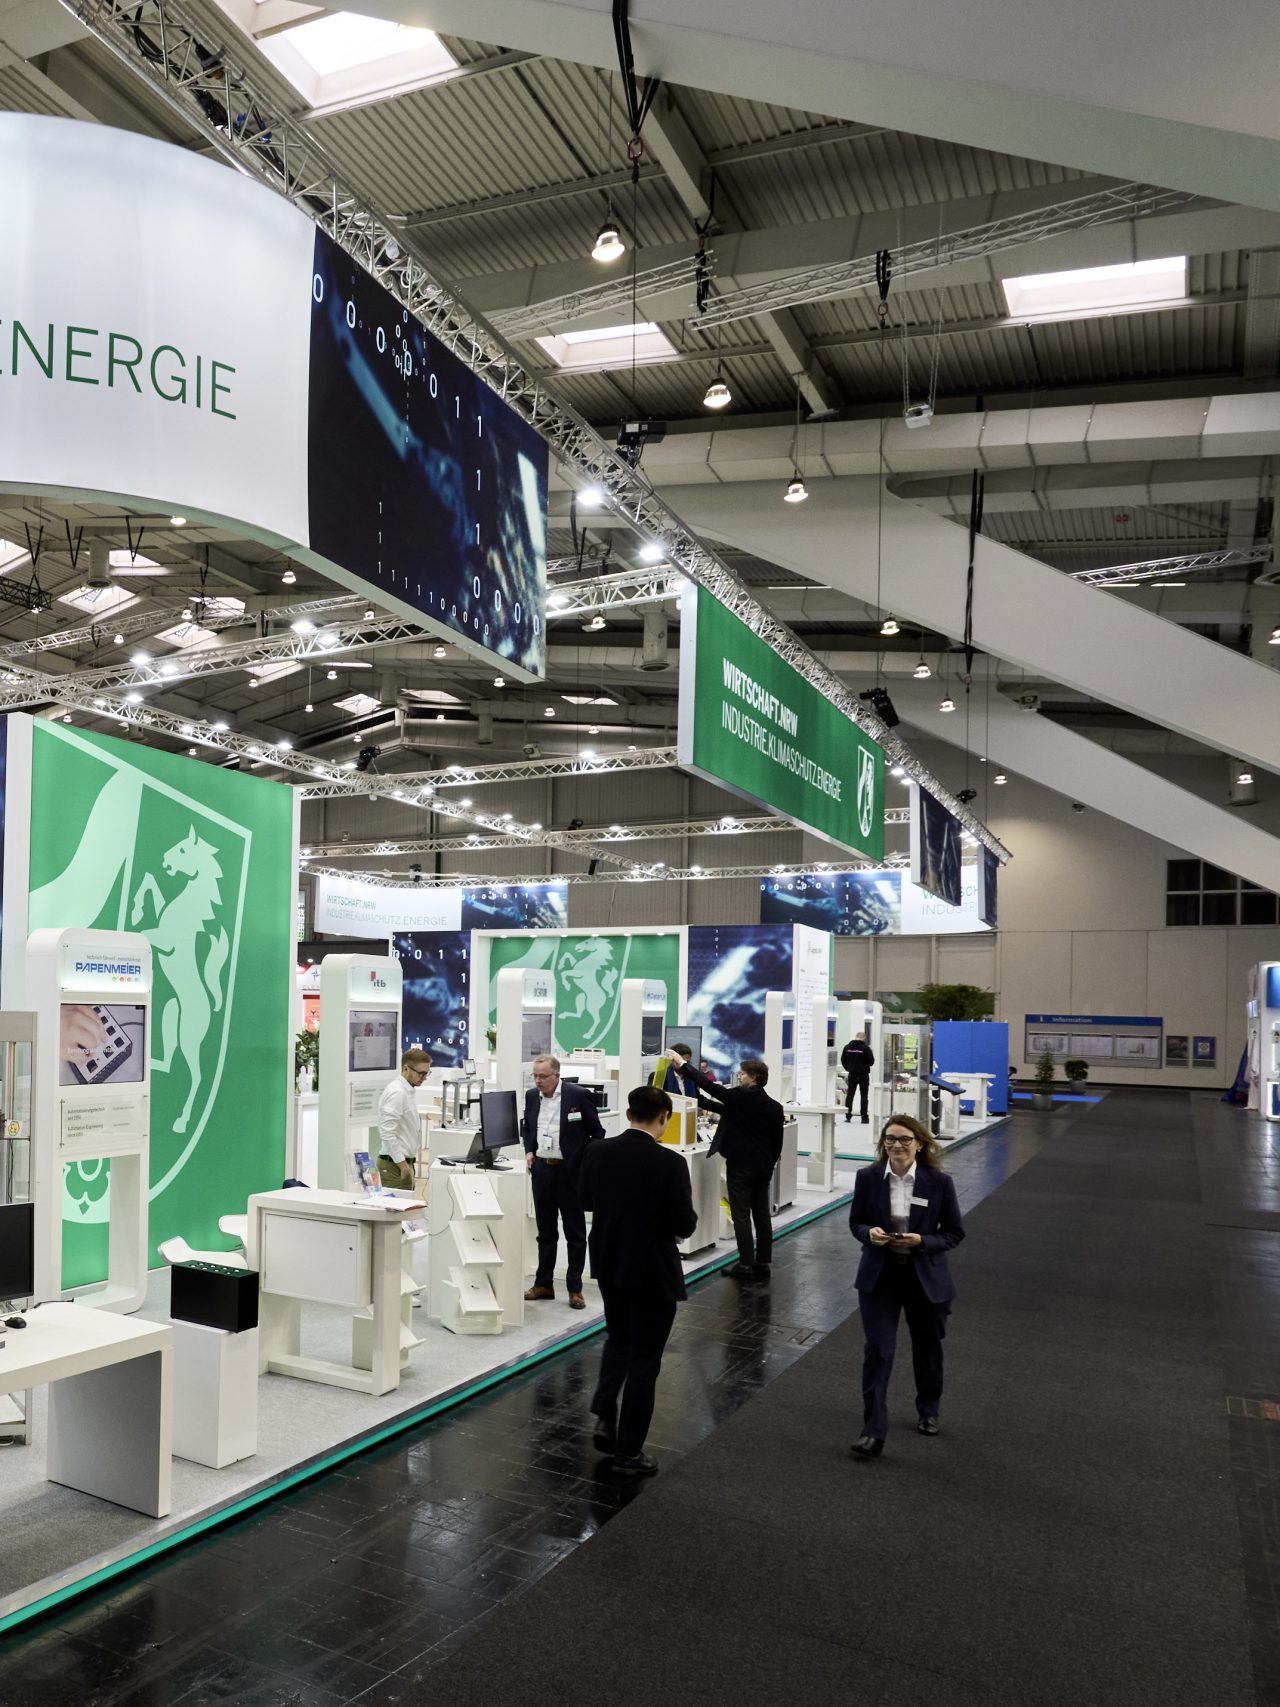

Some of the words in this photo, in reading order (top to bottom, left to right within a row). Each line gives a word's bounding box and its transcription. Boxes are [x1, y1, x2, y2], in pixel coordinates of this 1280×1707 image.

[722, 657, 799, 738] WIRTSCHAFT.NRW
[721, 700, 842, 802] INDUSTRIE.KLIMASCHUTZ.ENERGIE
[1052, 1016, 1093, 1024] Information
